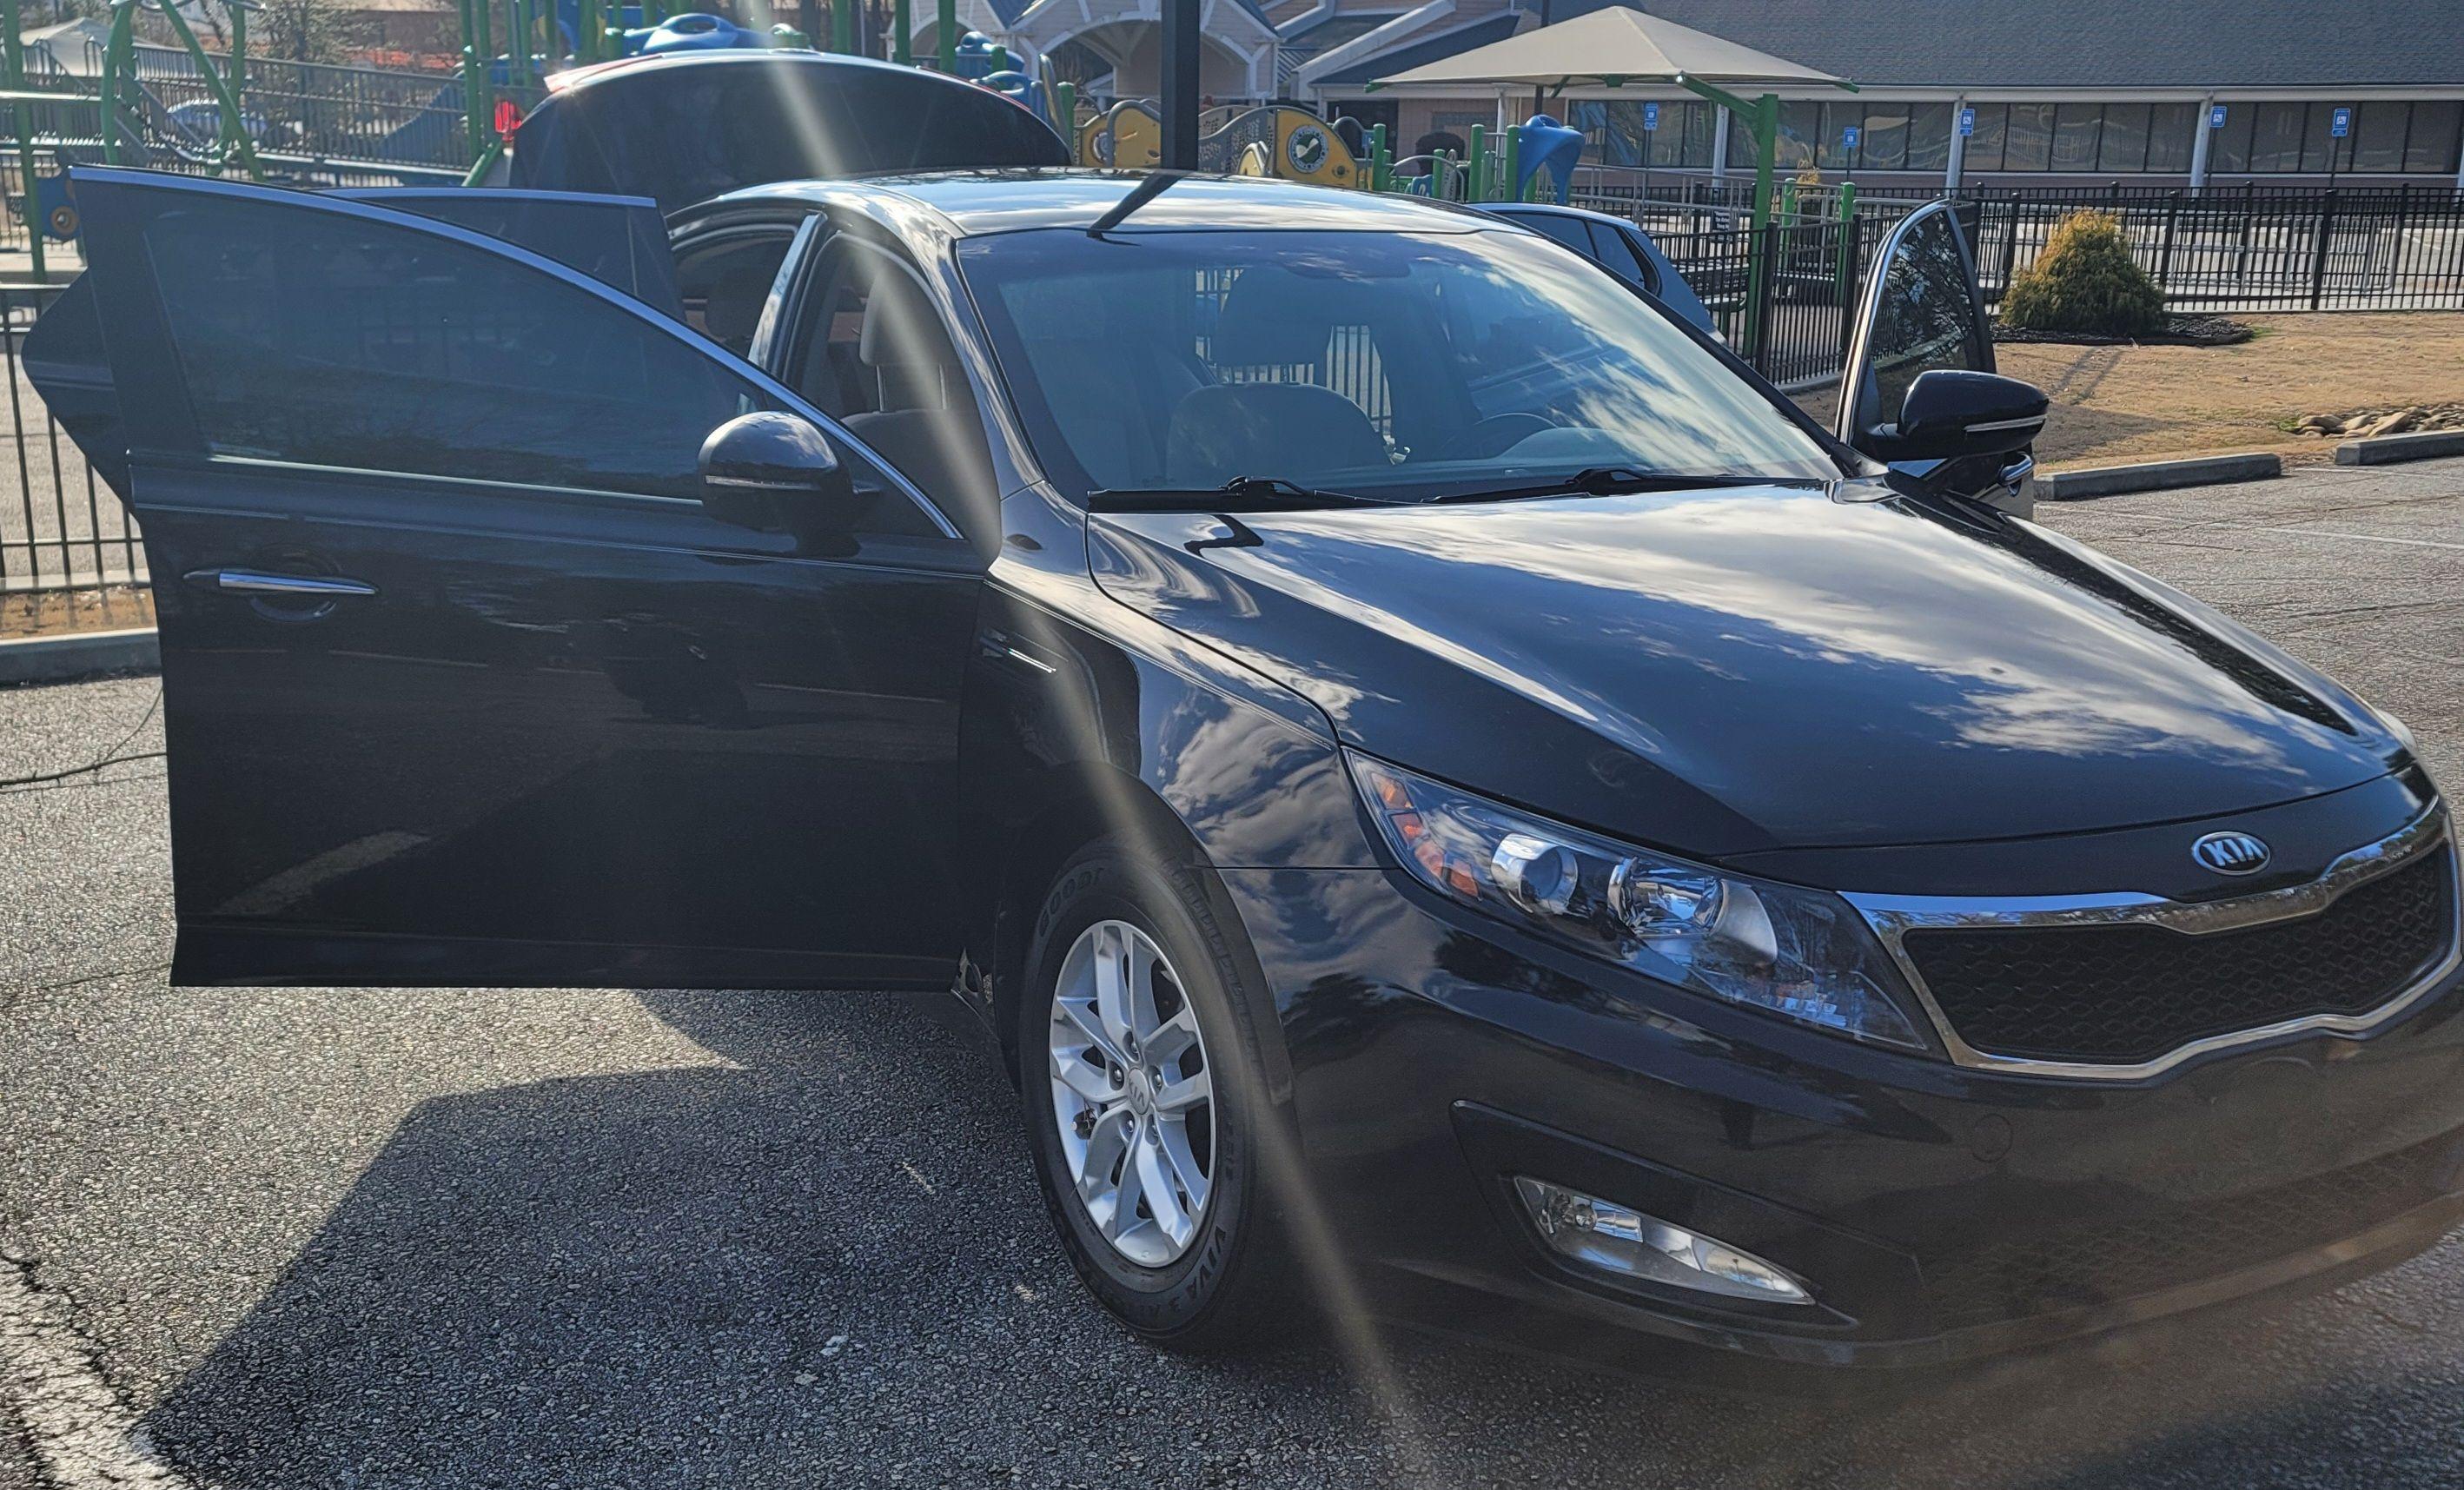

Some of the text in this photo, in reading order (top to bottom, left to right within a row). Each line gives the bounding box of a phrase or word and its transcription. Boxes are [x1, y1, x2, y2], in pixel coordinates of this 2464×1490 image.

[2202, 837, 2266, 867] KIA
[1129, 1078, 1145, 1107] KIA
[1186, 1225, 1226, 1299] VIVA
